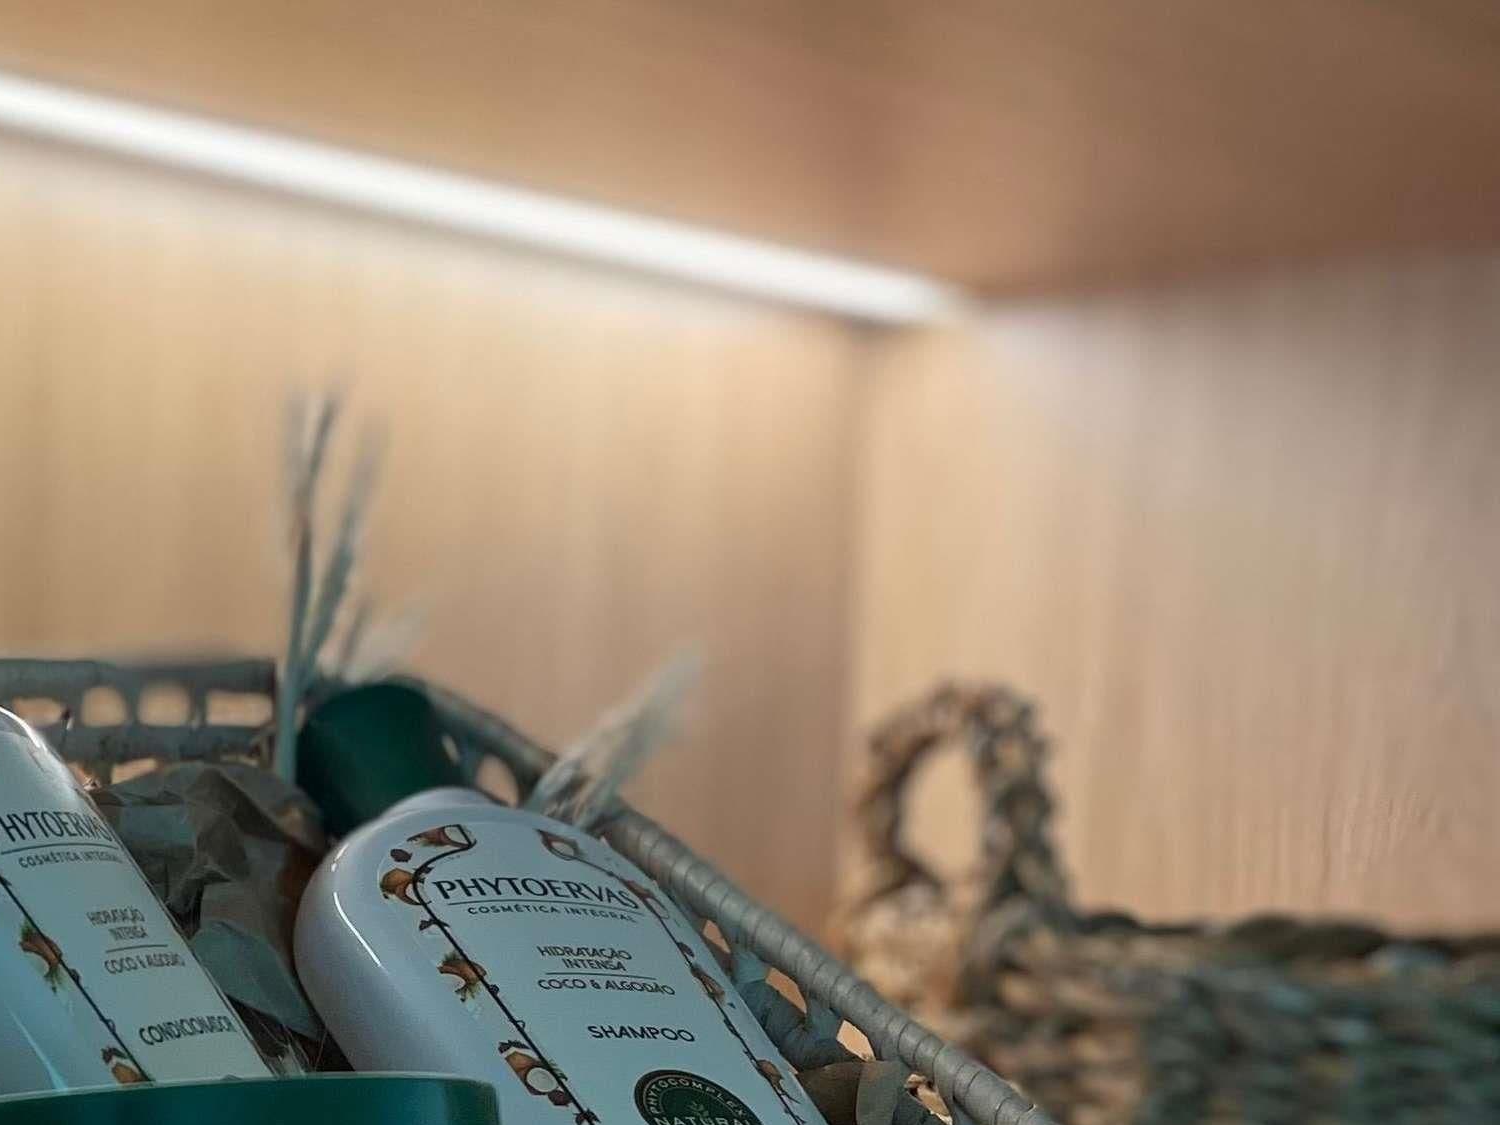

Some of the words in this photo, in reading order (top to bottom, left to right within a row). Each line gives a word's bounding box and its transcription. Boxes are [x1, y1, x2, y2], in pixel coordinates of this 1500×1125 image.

[433, 877, 639, 910] PHYTOERVAS
[468, 902, 559, 915] COSMÉTICA
[565, 907, 638, 924] INTEGRAL
[537, 946, 632, 961] HIDRATAÇÃO
[563, 958, 627, 972] INTENSA
[537, 979, 586, 990] COCO
[592, 979, 601, 990] &
[605, 980, 676, 996] ALGODÃO
[587, 1025, 696, 1043] SHAMPOO
[649, 1078, 748, 1117] PHYTOCOMPLEX
